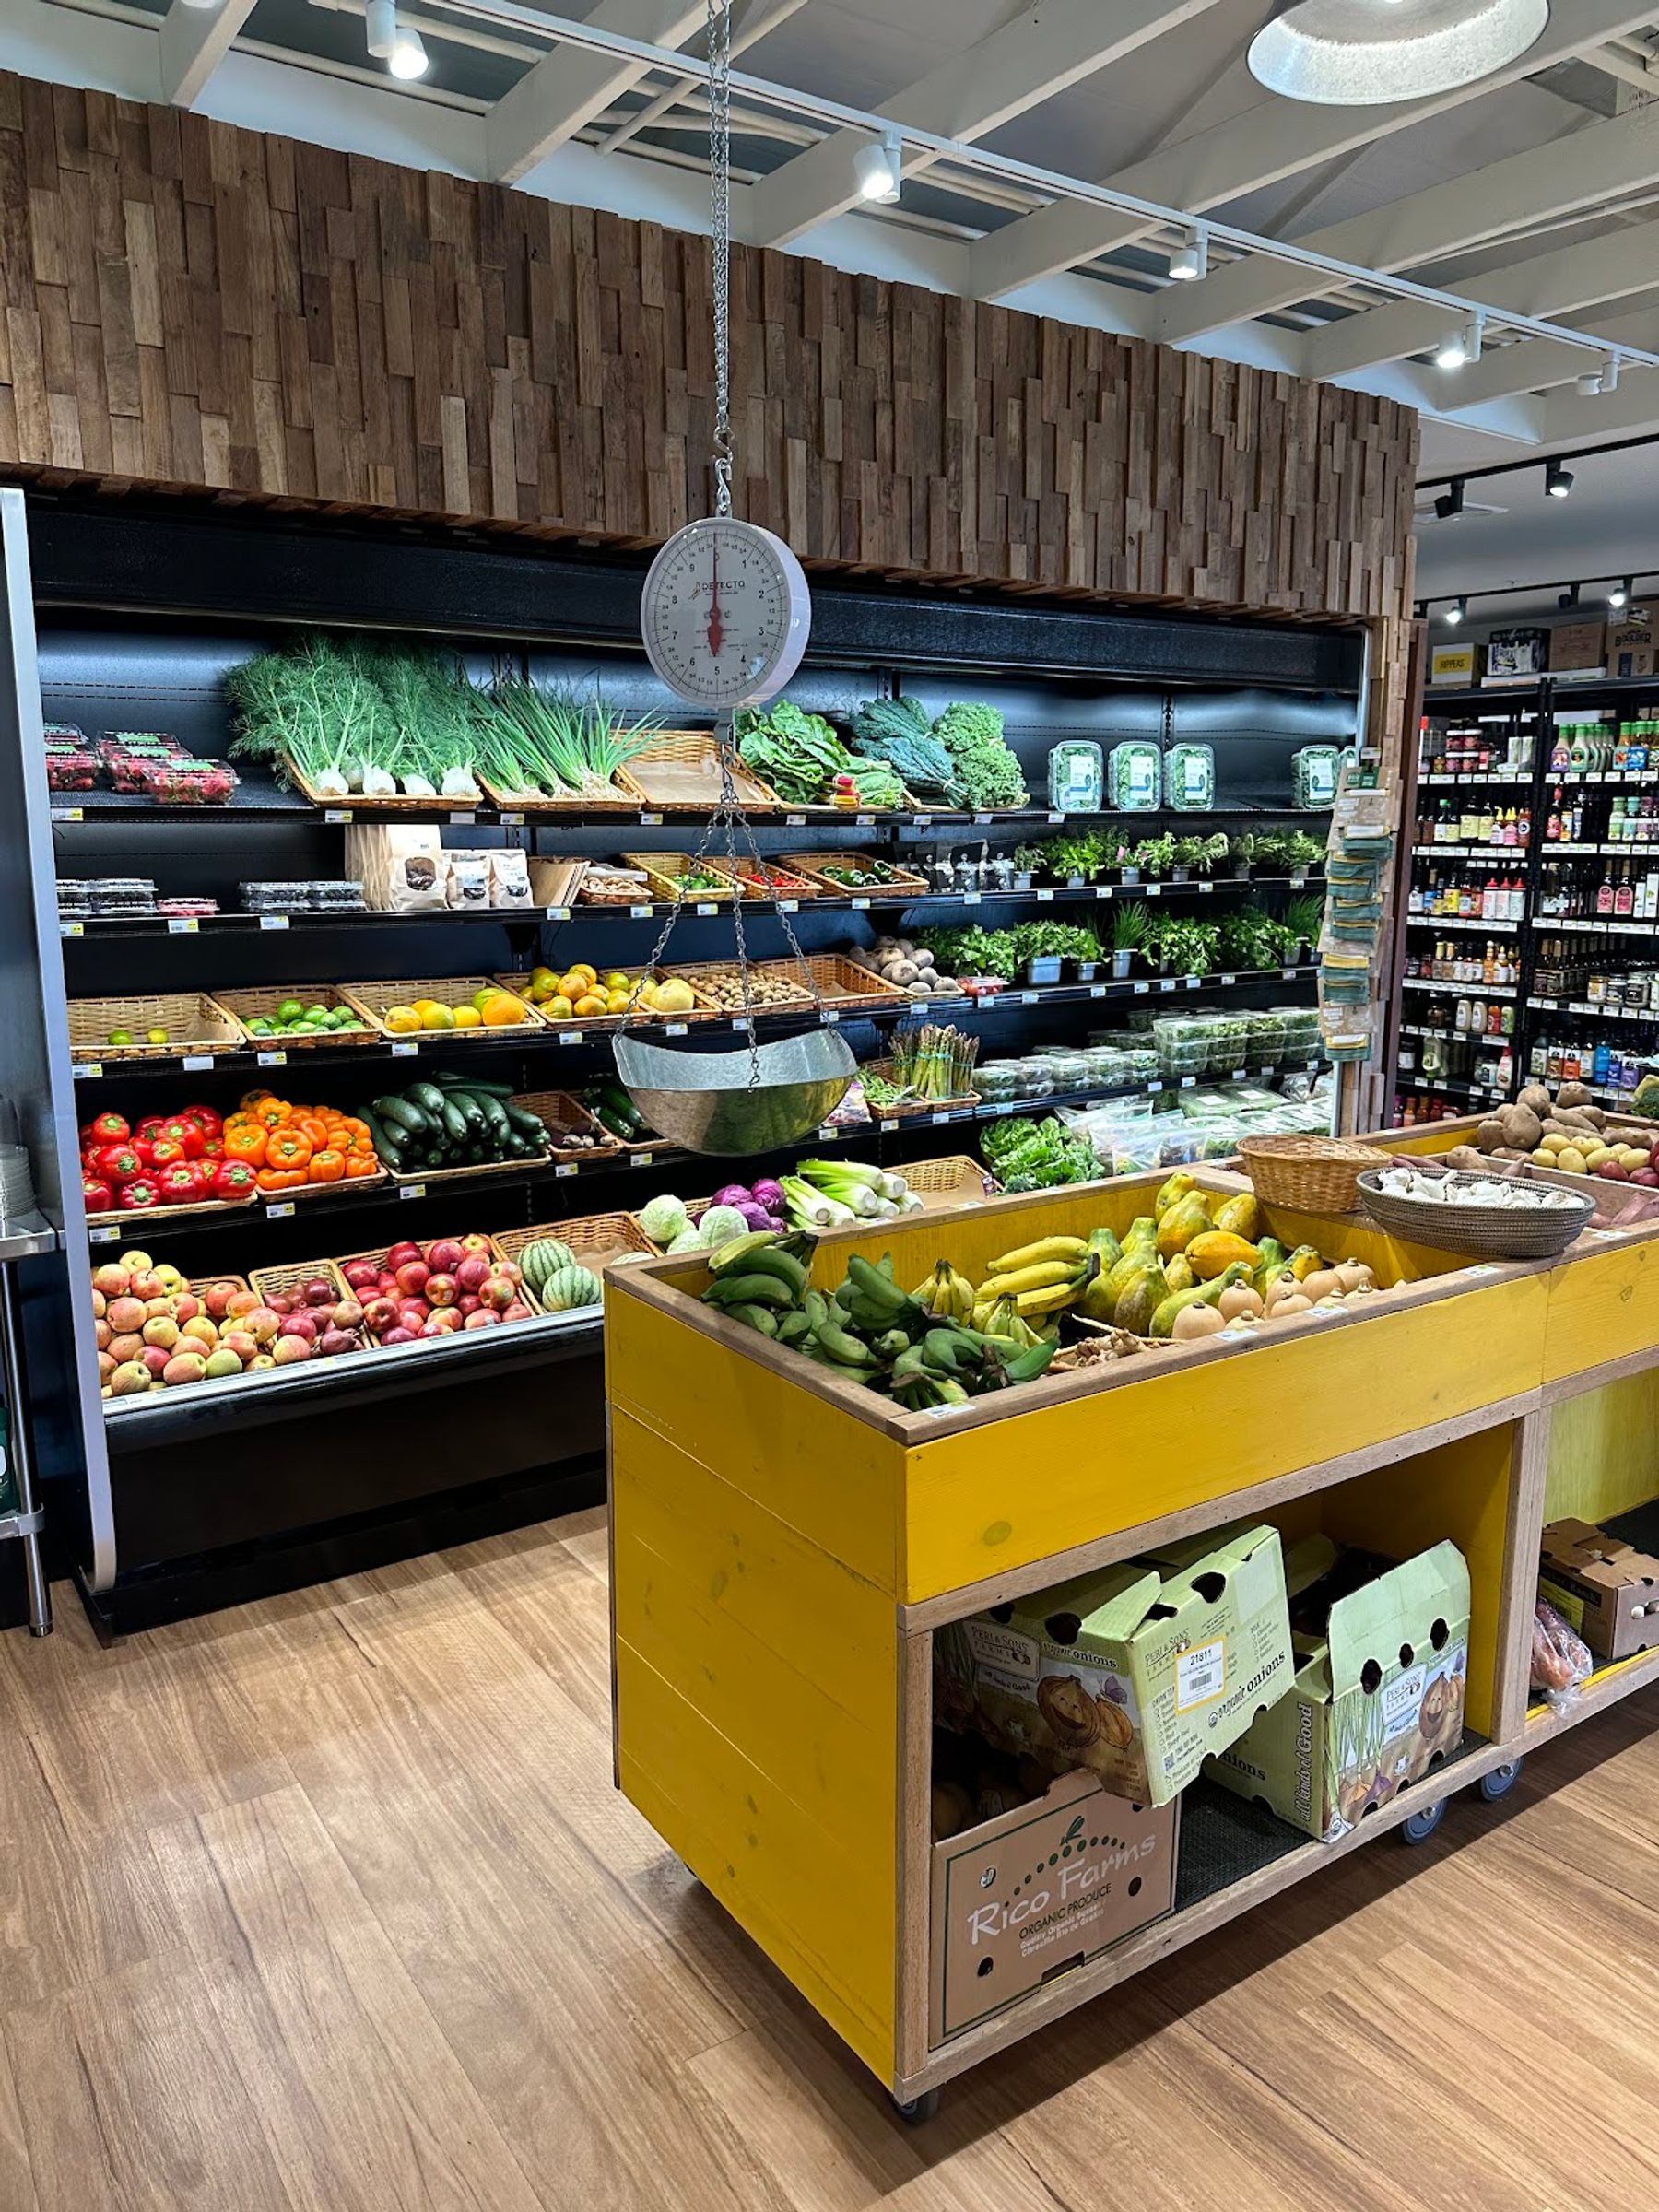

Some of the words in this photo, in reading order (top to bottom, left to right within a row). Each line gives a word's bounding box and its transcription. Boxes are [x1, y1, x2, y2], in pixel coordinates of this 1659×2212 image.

[688, 563, 695, 572] 9
[671, 595, 677, 605] 8
[759, 590, 765, 599] 2
[672, 630, 677, 641] 7
[759, 626, 765, 636] 3
[689, 657, 696, 666] 6
[714, 666, 721, 676] 5
[1073, 1650, 1117, 1668] onions
[1145, 1647, 1164, 1665] PERI
[1190, 1648, 1212, 1665] 21811
[1246, 1651, 1286, 1692] onions
[1296, 1702, 1313, 1754] Good
[1221, 1753, 1266, 1781] nions
[967, 1890, 1051, 1946] Rico
[1056, 1833, 1157, 1900] Farms
[1018, 1907, 1065, 1939] ORGANIC
[1067, 1882, 1112, 1915] PRODUCE
